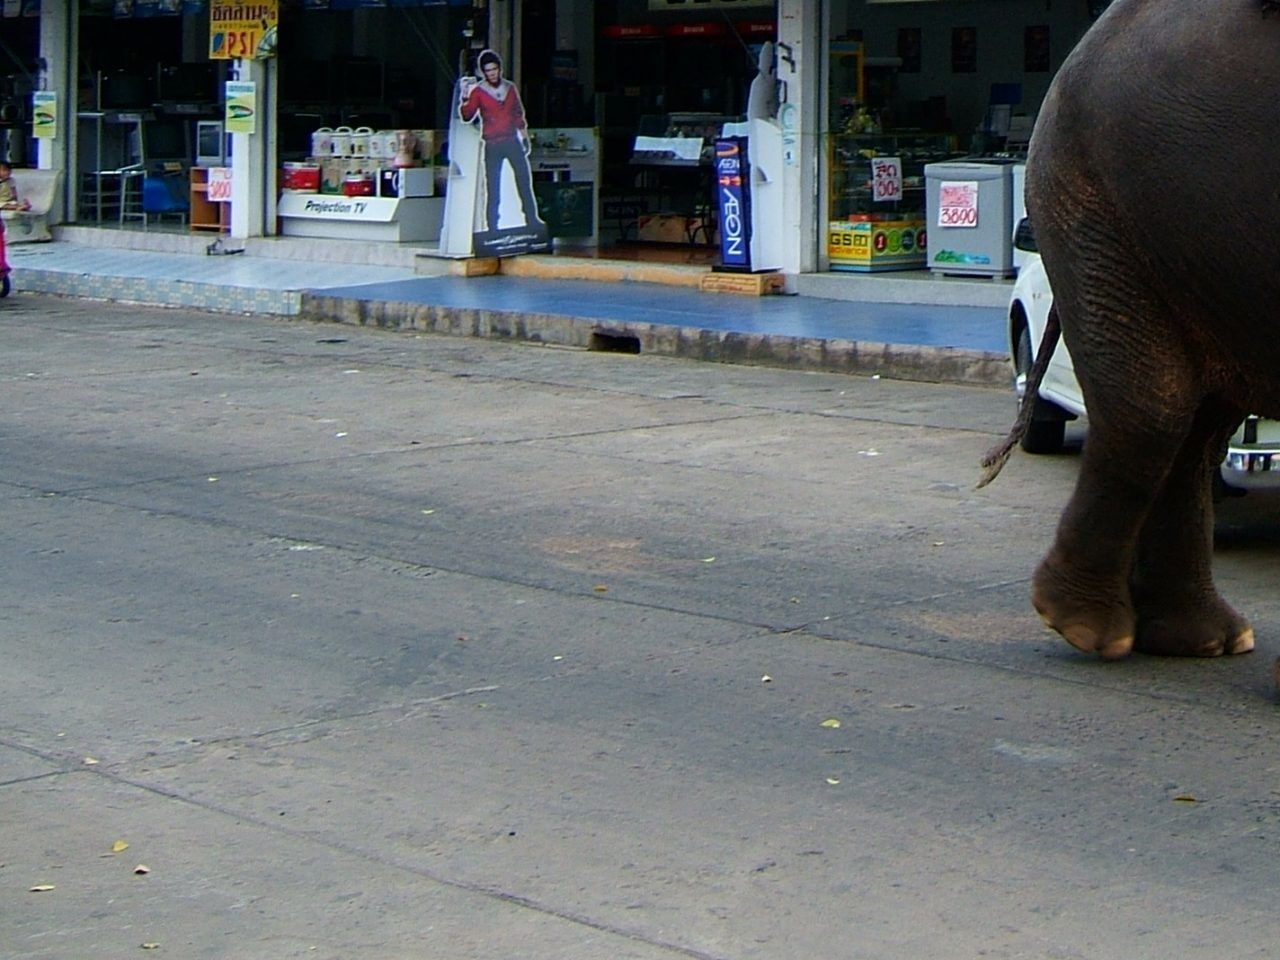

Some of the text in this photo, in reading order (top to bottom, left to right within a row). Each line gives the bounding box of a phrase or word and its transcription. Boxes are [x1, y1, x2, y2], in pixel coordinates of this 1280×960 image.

[228, 31, 255, 54] PSI
[304, 200, 367, 213] Projection TV
[831, 233, 868, 246] GSM
